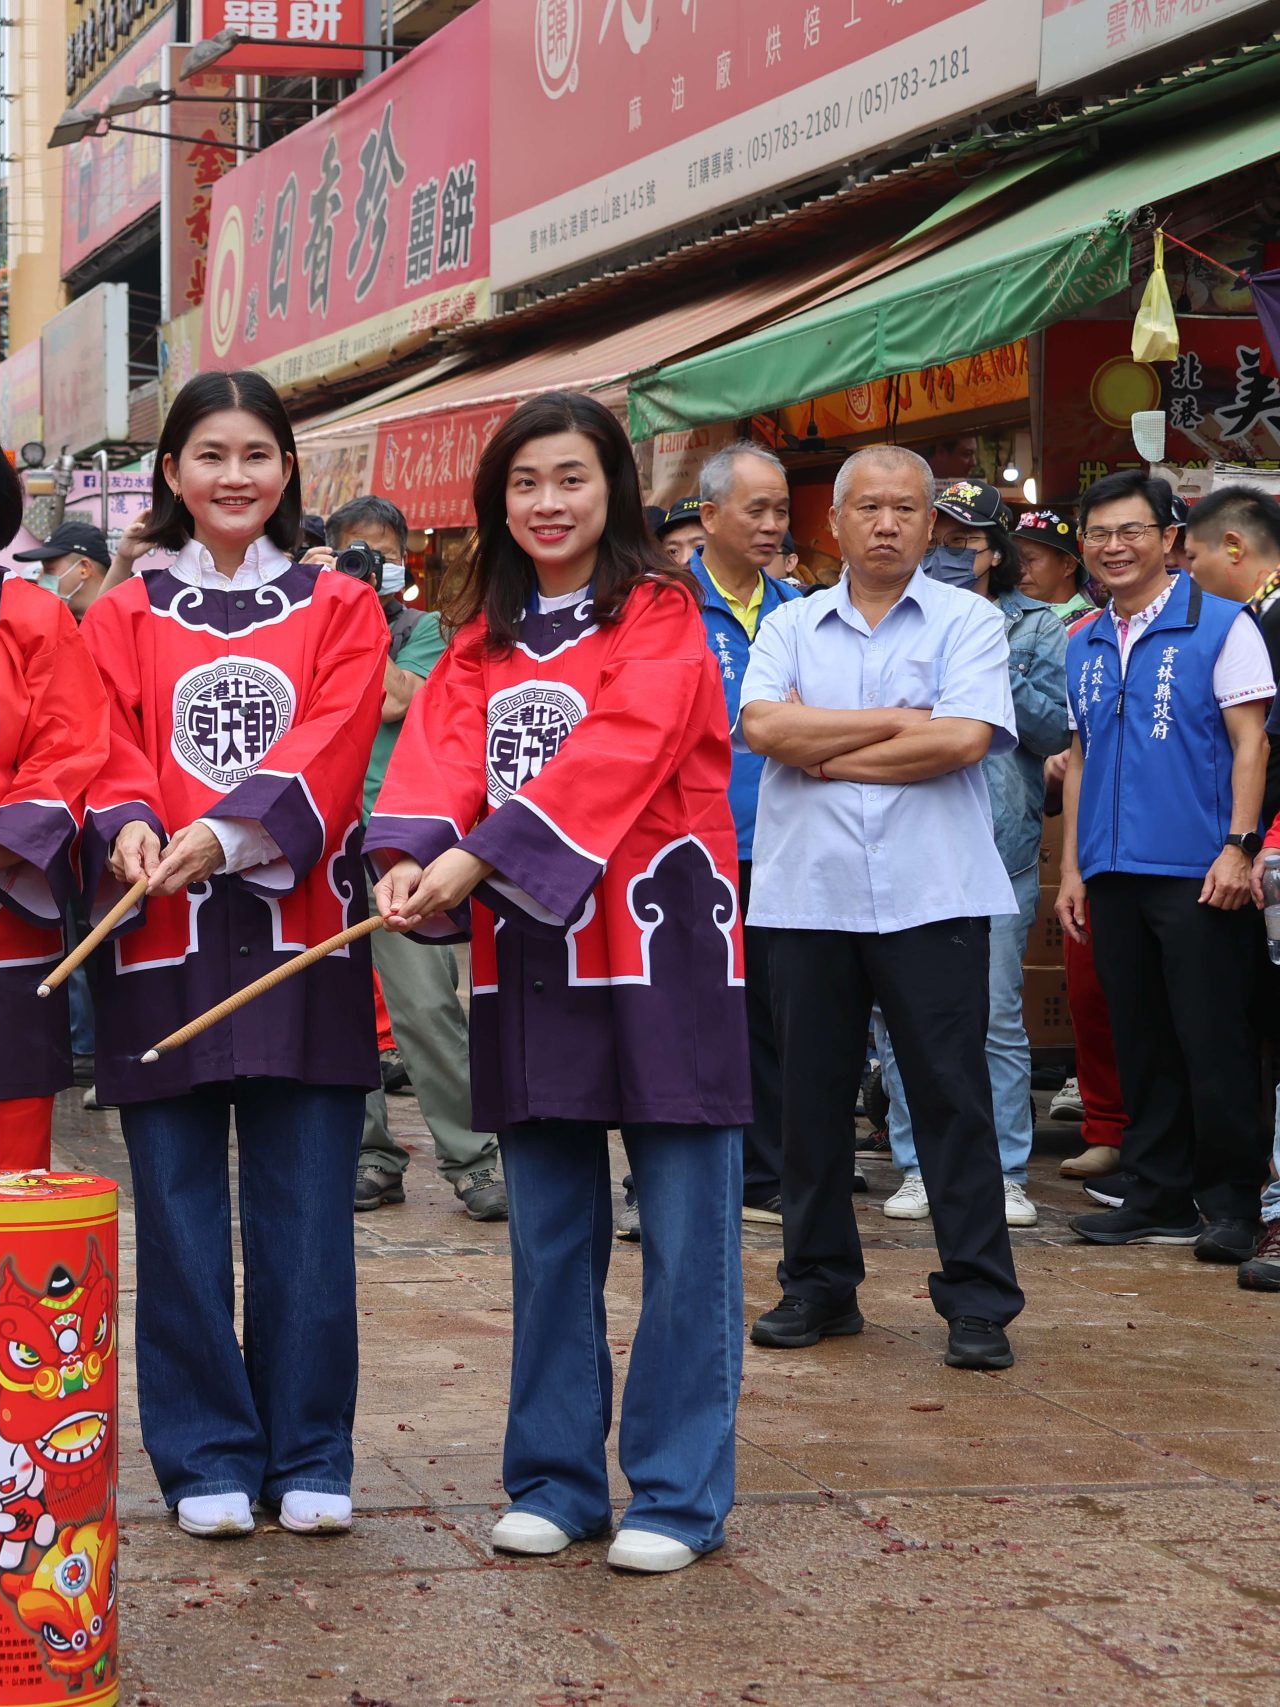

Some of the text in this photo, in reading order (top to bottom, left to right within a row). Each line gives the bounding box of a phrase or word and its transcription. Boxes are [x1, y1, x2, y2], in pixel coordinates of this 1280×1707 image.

[1105, 0, 1222, 49] 雲林縣北
[628, 50, 731, 133] 麻油廠
[858, 45, 970, 123] (05)783-2181
[404, 158, 477, 288] 囍餅
[1172, 352, 1203, 430] 北港
[715, 632, 735, 680] 警察局
[1149, 647, 1179, 740] 雲林縣政府
